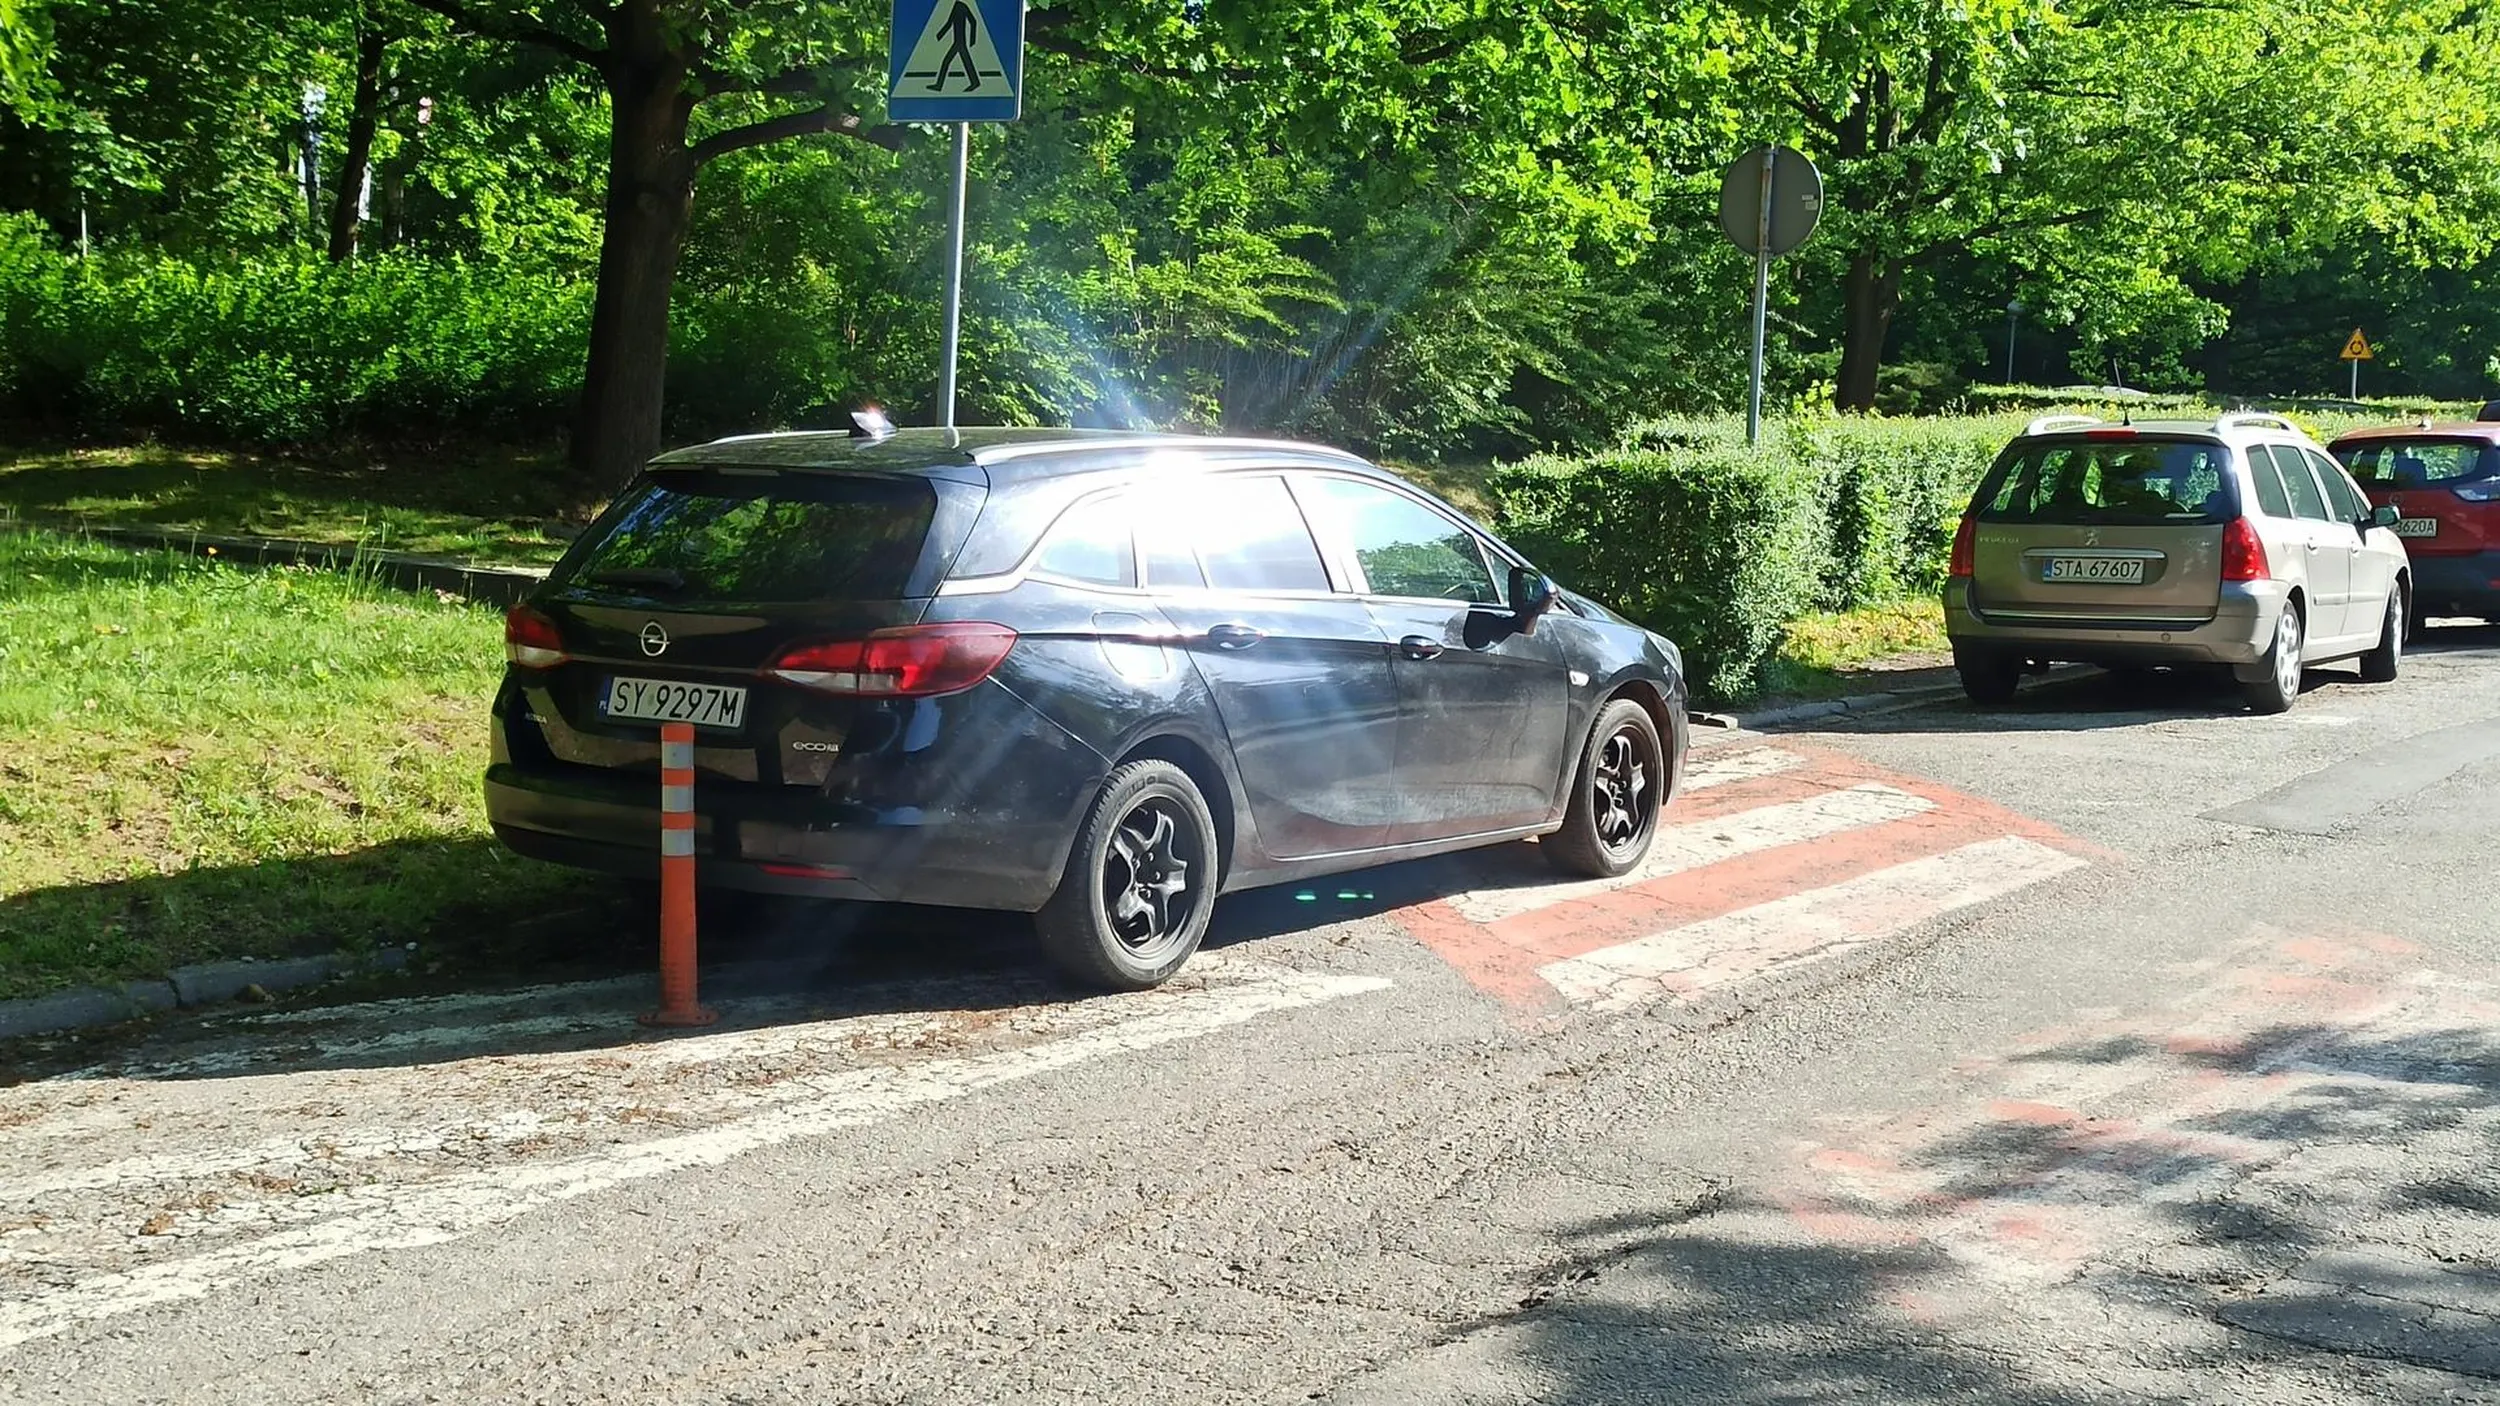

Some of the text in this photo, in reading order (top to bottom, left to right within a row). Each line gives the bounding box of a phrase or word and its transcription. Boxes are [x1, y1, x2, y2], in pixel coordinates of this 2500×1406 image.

[2053, 560, 2141, 578] STA 67607
[614, 681, 739, 724] SY 9297M
